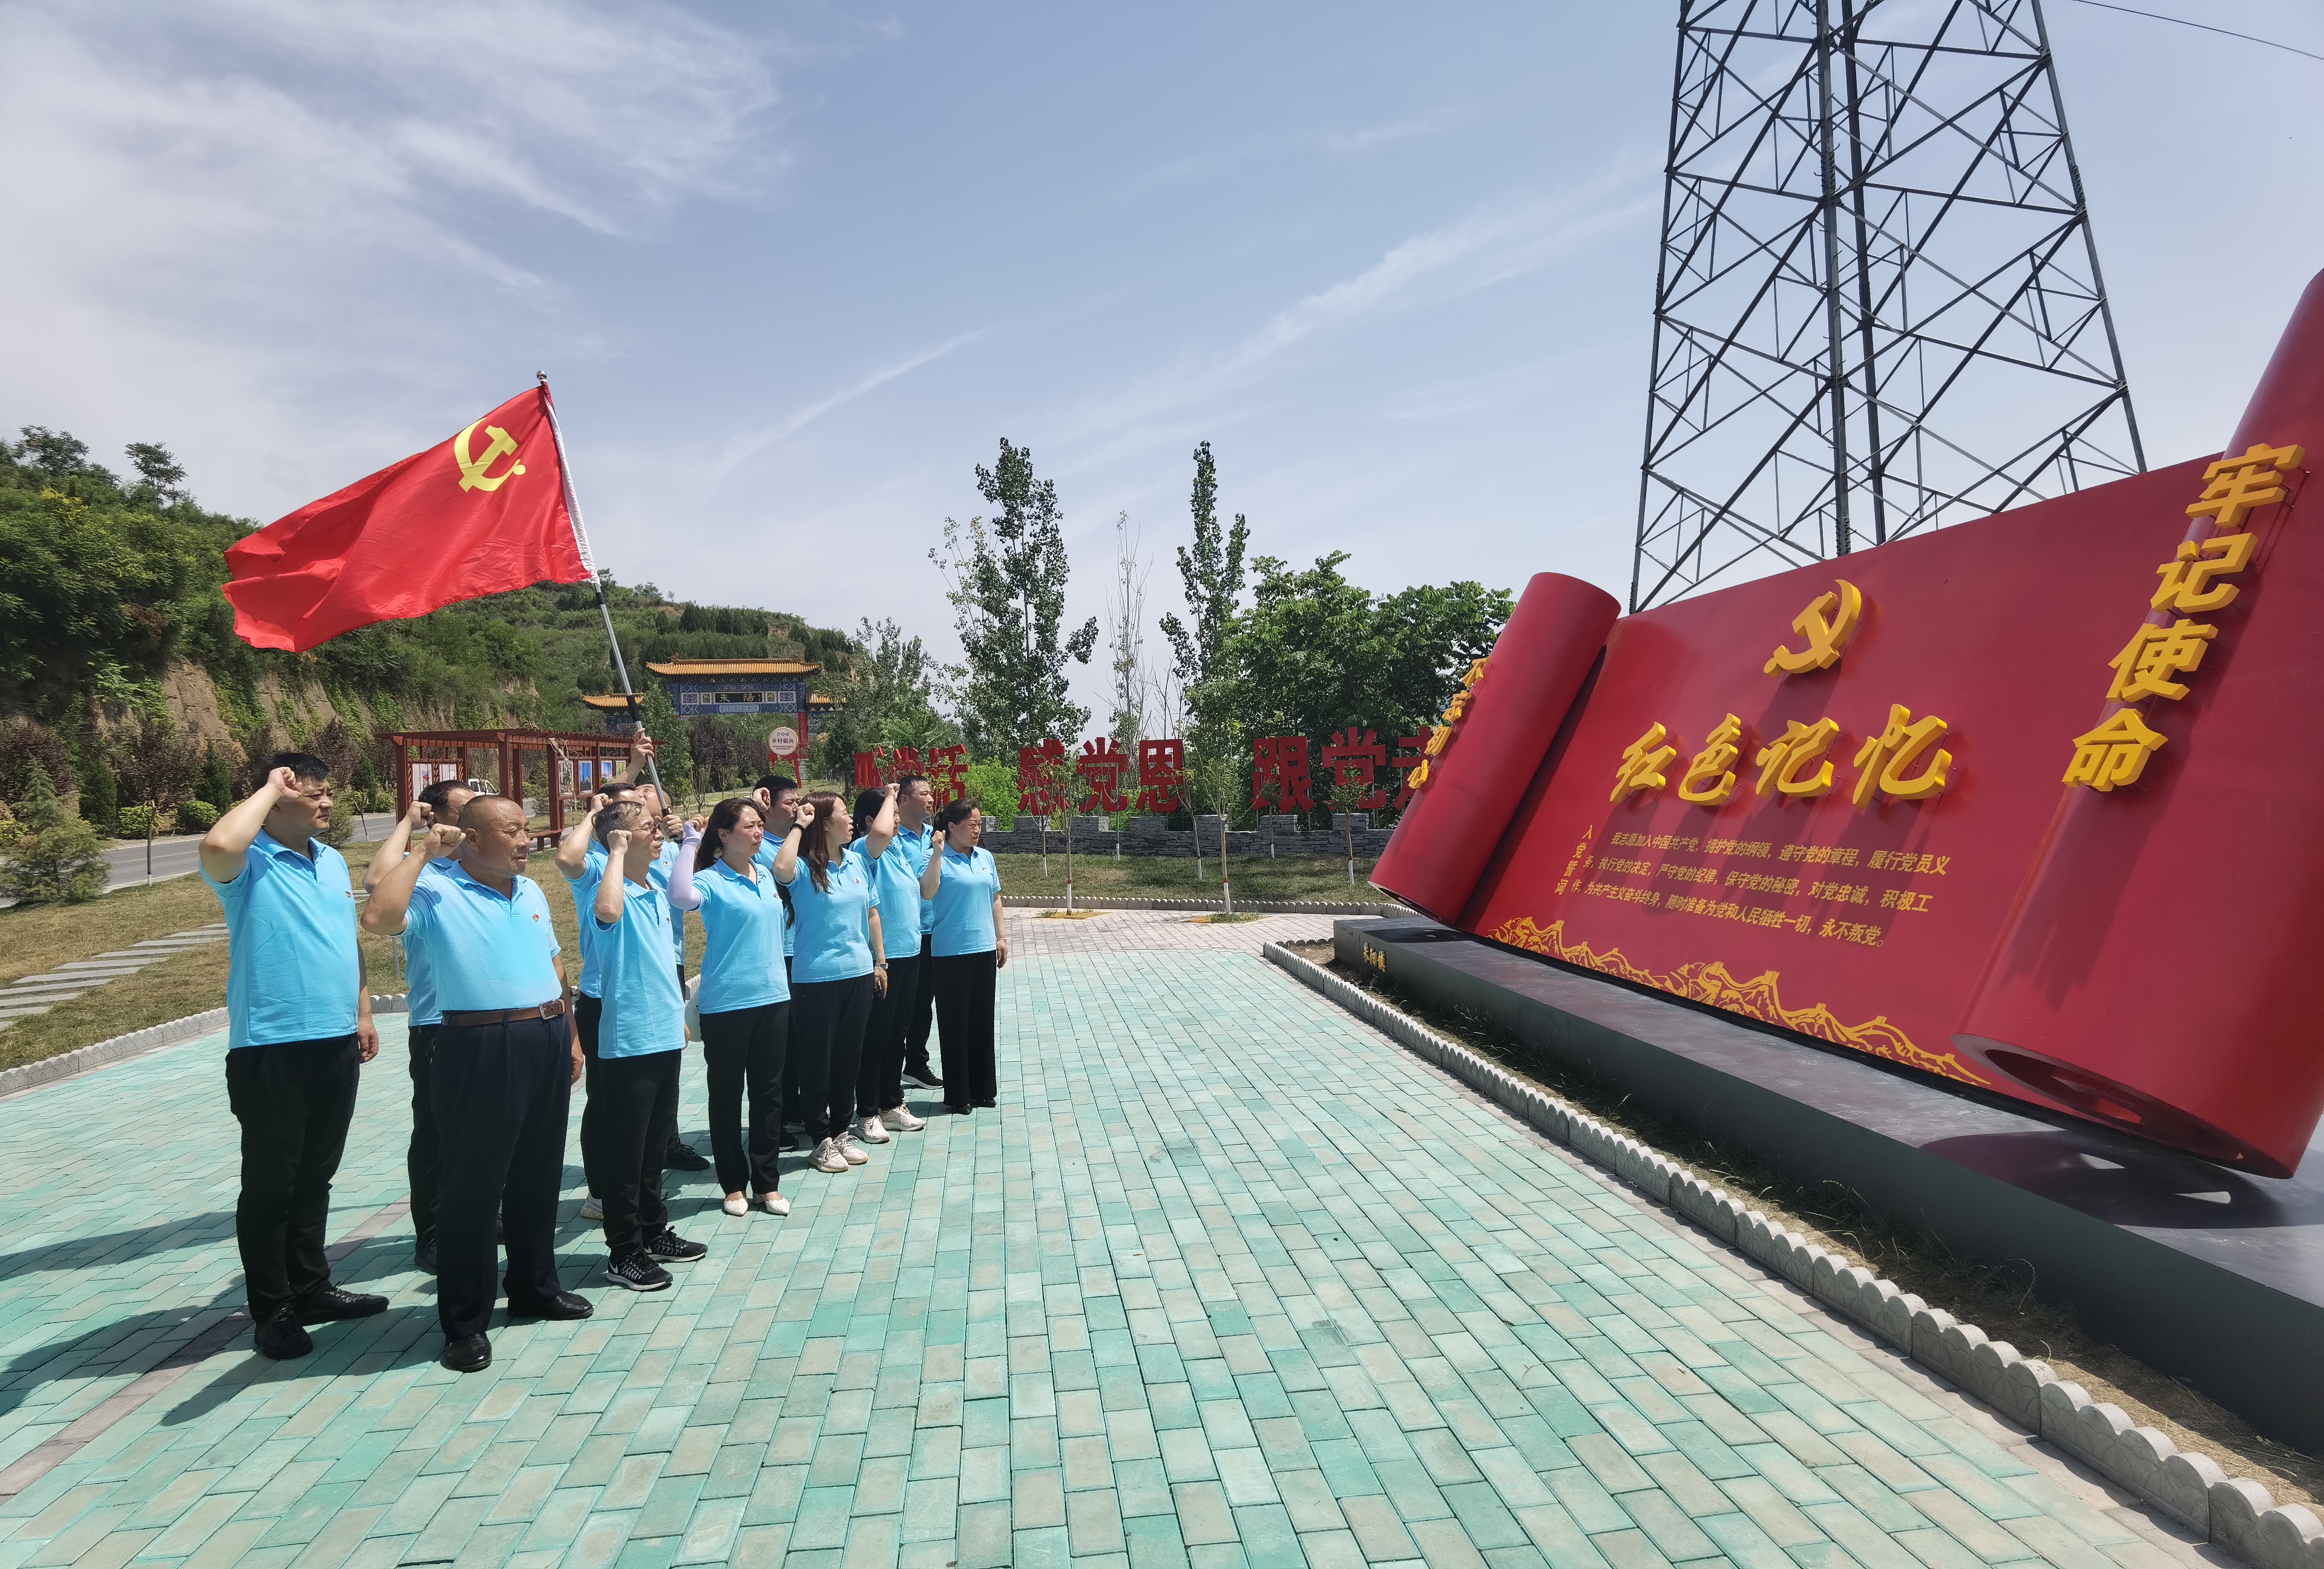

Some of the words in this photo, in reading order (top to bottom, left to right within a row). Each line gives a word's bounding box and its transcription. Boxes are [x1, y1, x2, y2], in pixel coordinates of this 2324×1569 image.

[2061, 443, 2305, 792] 牢记使命
[1407, 657, 1490, 789] 不忘初心
[1610, 703, 1952, 809] 红色记忆
[1017, 737, 1190, 816] 感党恩
[1554, 824, 1593, 895] 入党誓词
